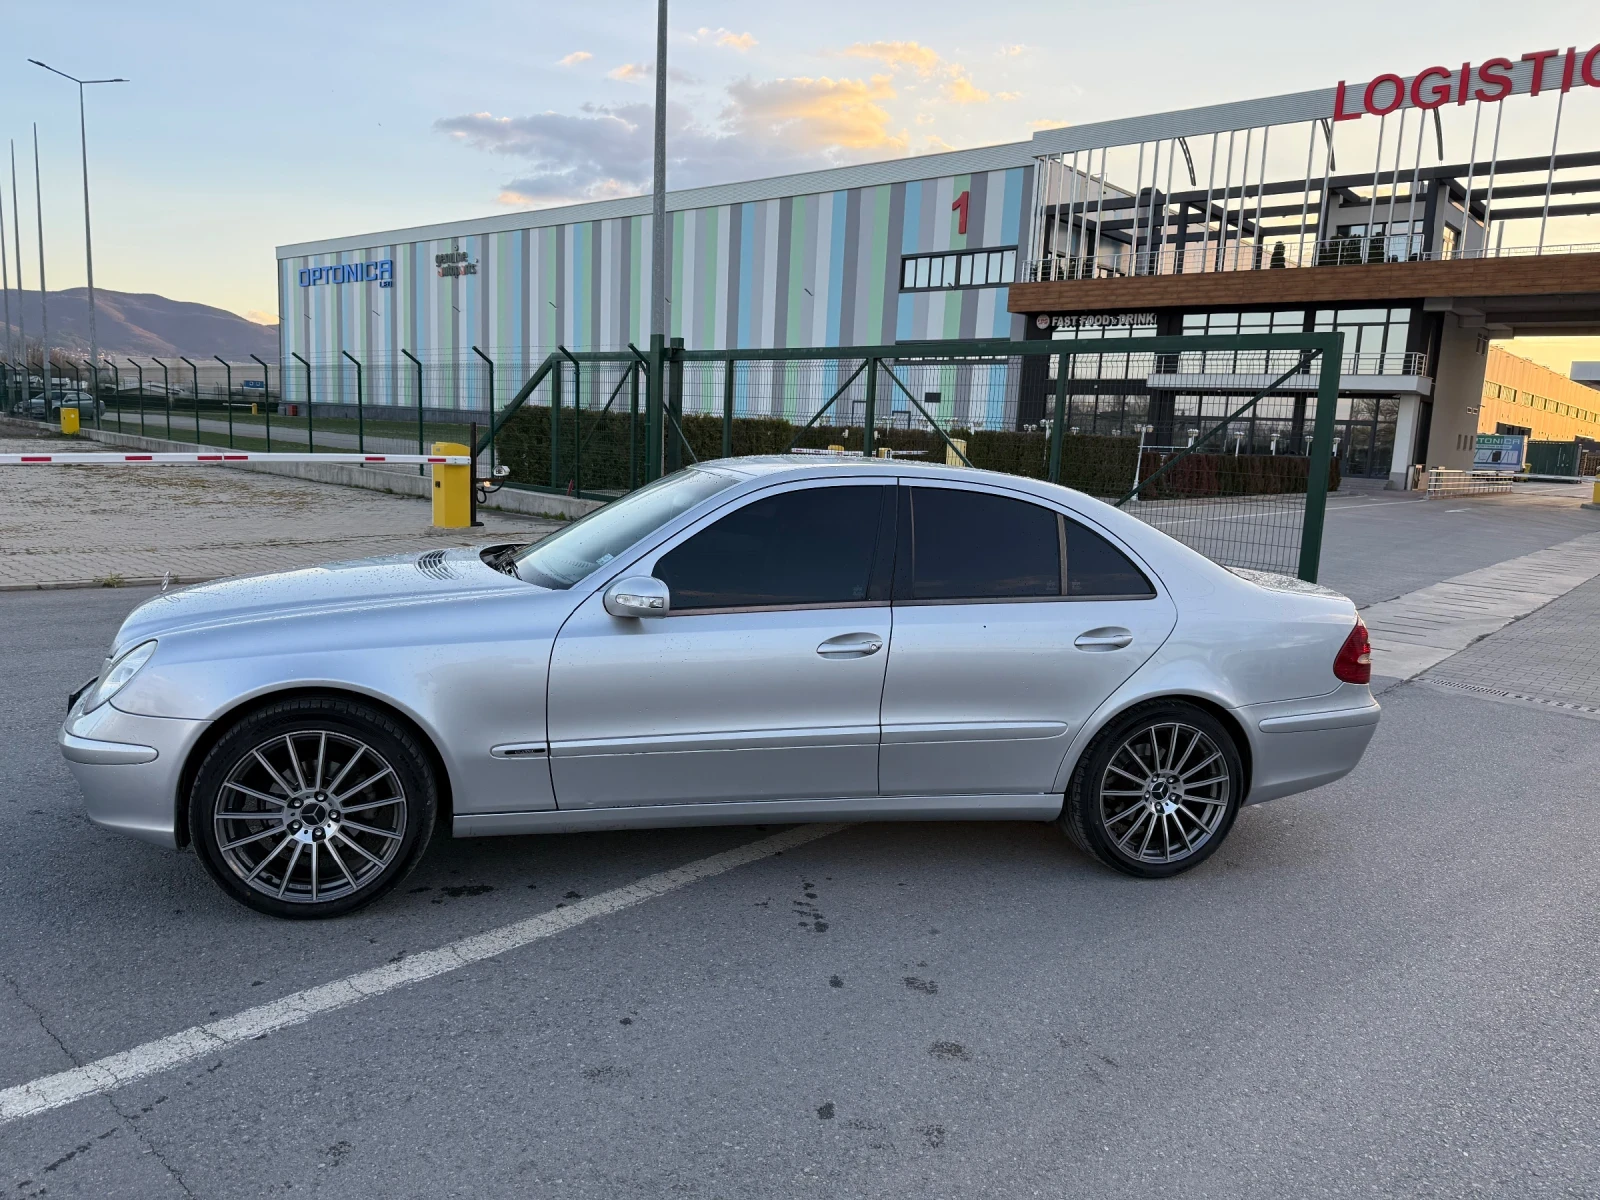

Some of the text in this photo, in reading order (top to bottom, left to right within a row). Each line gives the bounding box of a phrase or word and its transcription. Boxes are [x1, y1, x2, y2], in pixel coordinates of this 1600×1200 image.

[952, 190, 969, 235] 1
[298, 259, 393, 287] OPTONICA
[1051, 315, 1079, 327] FAST
[1080, 314, 1111, 326] FOOD
[1118, 313, 1156, 325] DRINK
[1475, 437, 1520, 445] TONICA
